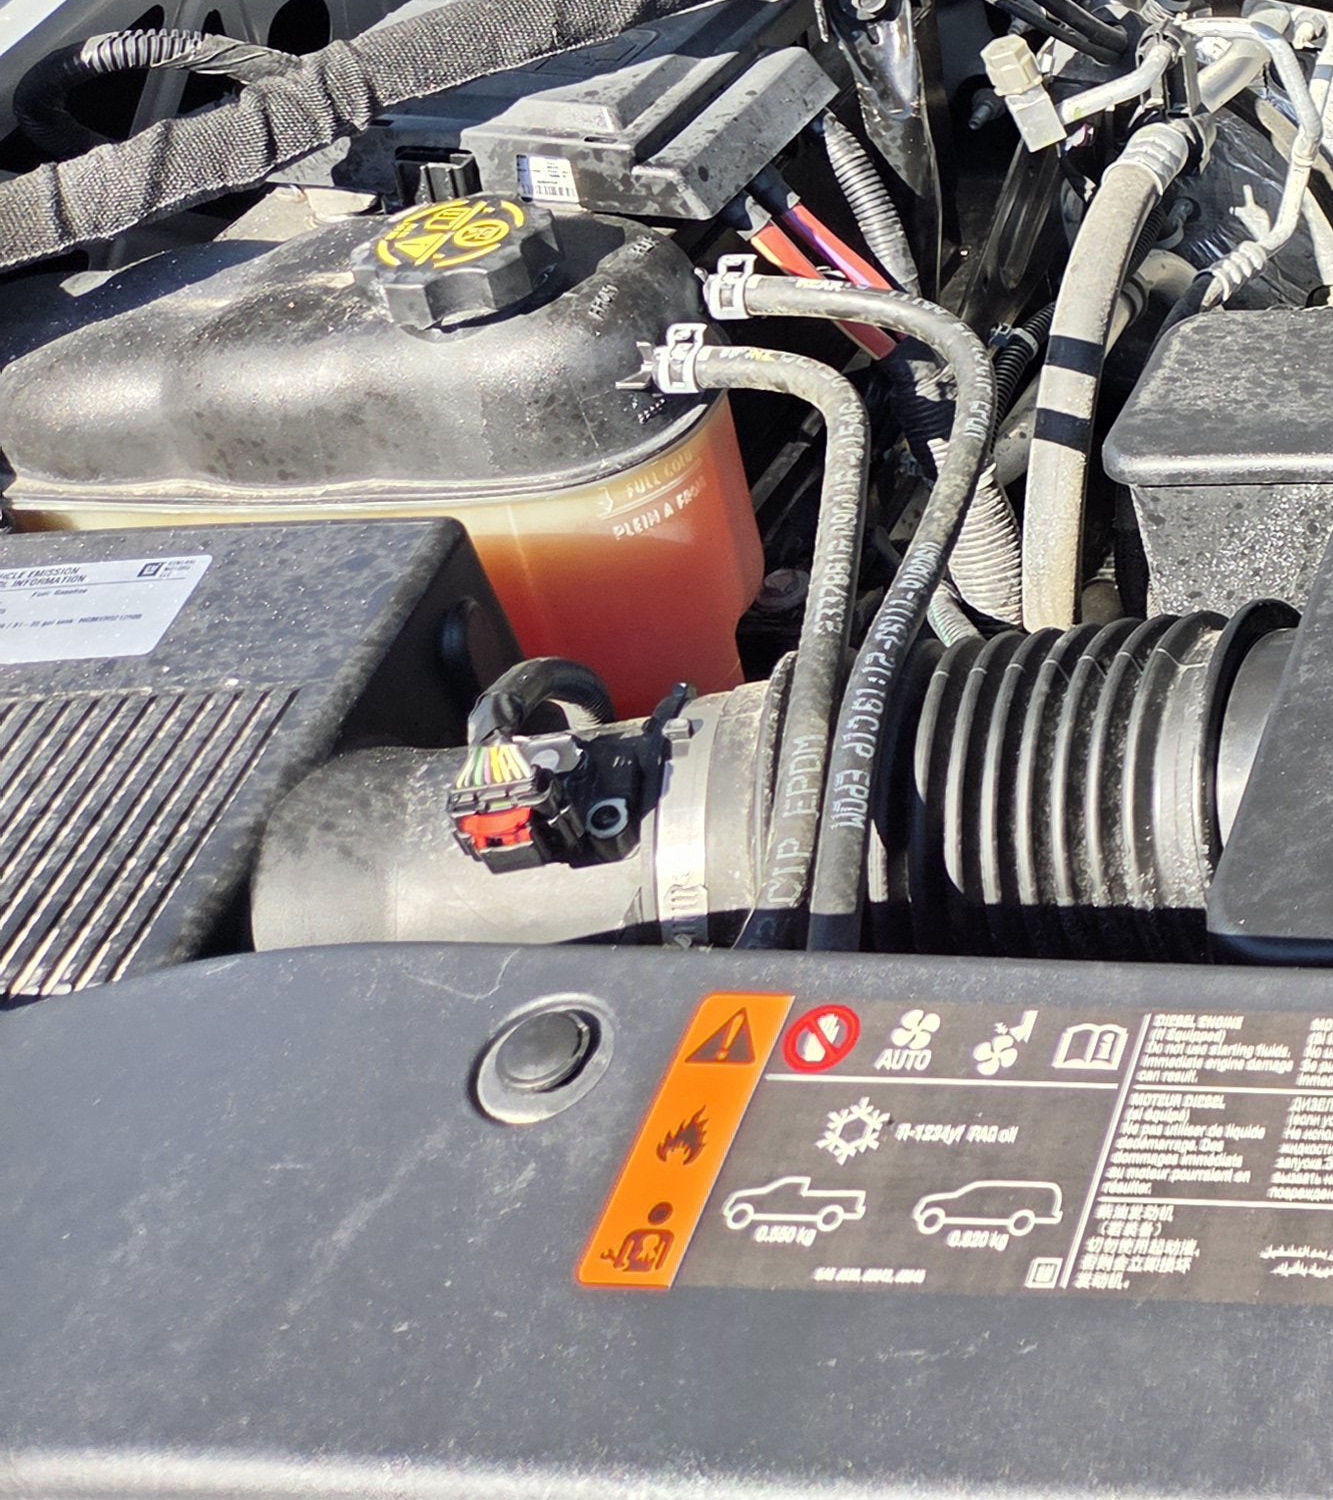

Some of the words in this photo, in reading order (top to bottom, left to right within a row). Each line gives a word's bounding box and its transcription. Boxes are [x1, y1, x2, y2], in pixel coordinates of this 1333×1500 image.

[626, 471, 661, 498] FULL
[612, 509, 661, 540] PLEIN
[664, 501, 674, 518] A
[11, 575, 87, 587] INFORMATION
[27, 567, 80, 578] EMISSION
[781, 733, 827, 818] EPDM
[767, 837, 811, 906] CIP
[874, 1049, 931, 1070] AUTO
[1165, 1042, 1185, 1054] not
